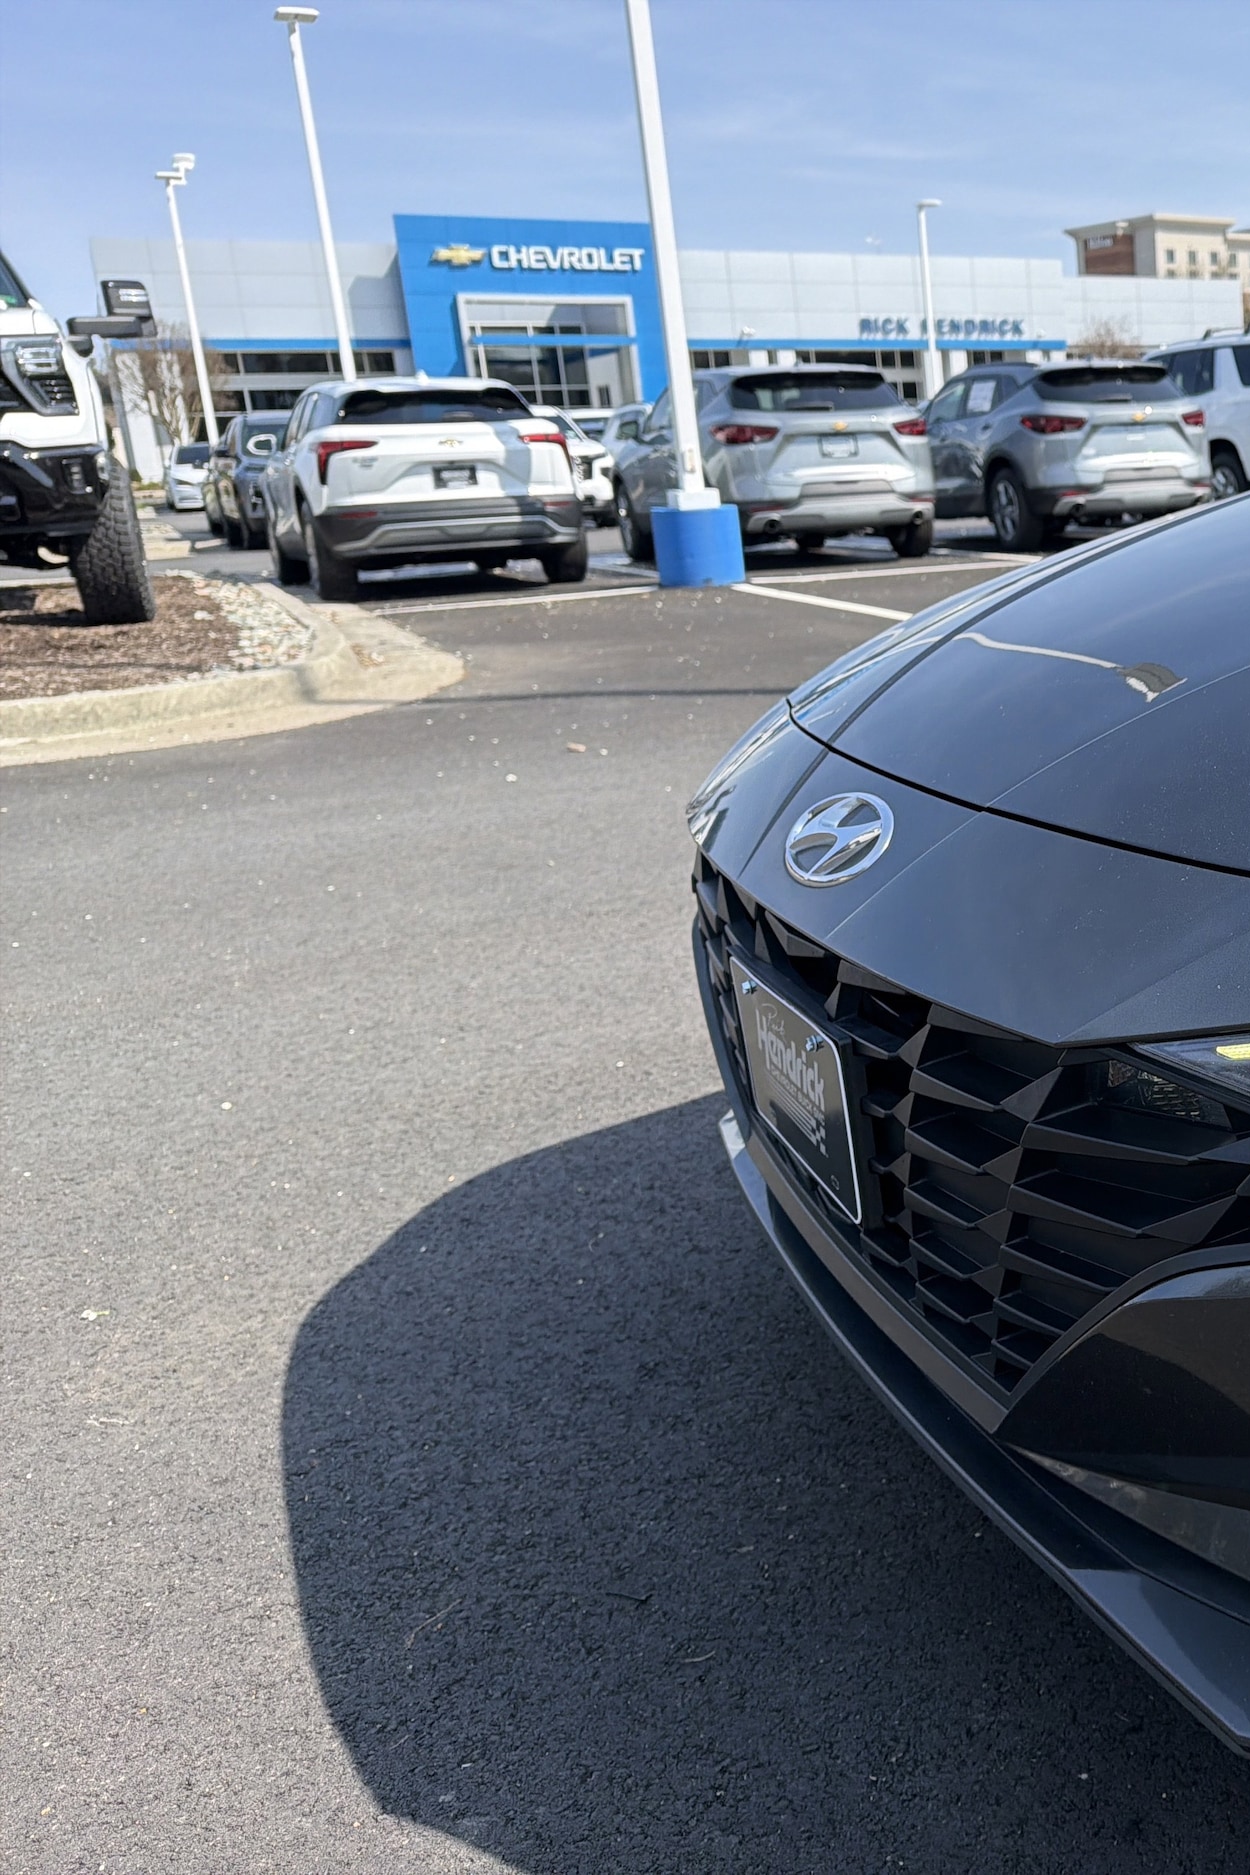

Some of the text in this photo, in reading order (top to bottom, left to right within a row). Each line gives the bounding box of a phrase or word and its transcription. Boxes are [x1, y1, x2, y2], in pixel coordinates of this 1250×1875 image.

[490, 244, 645, 272] CHEVROLET
[859, 318, 910, 337] RICK
[755, 1008, 825, 1113] Hendrick
